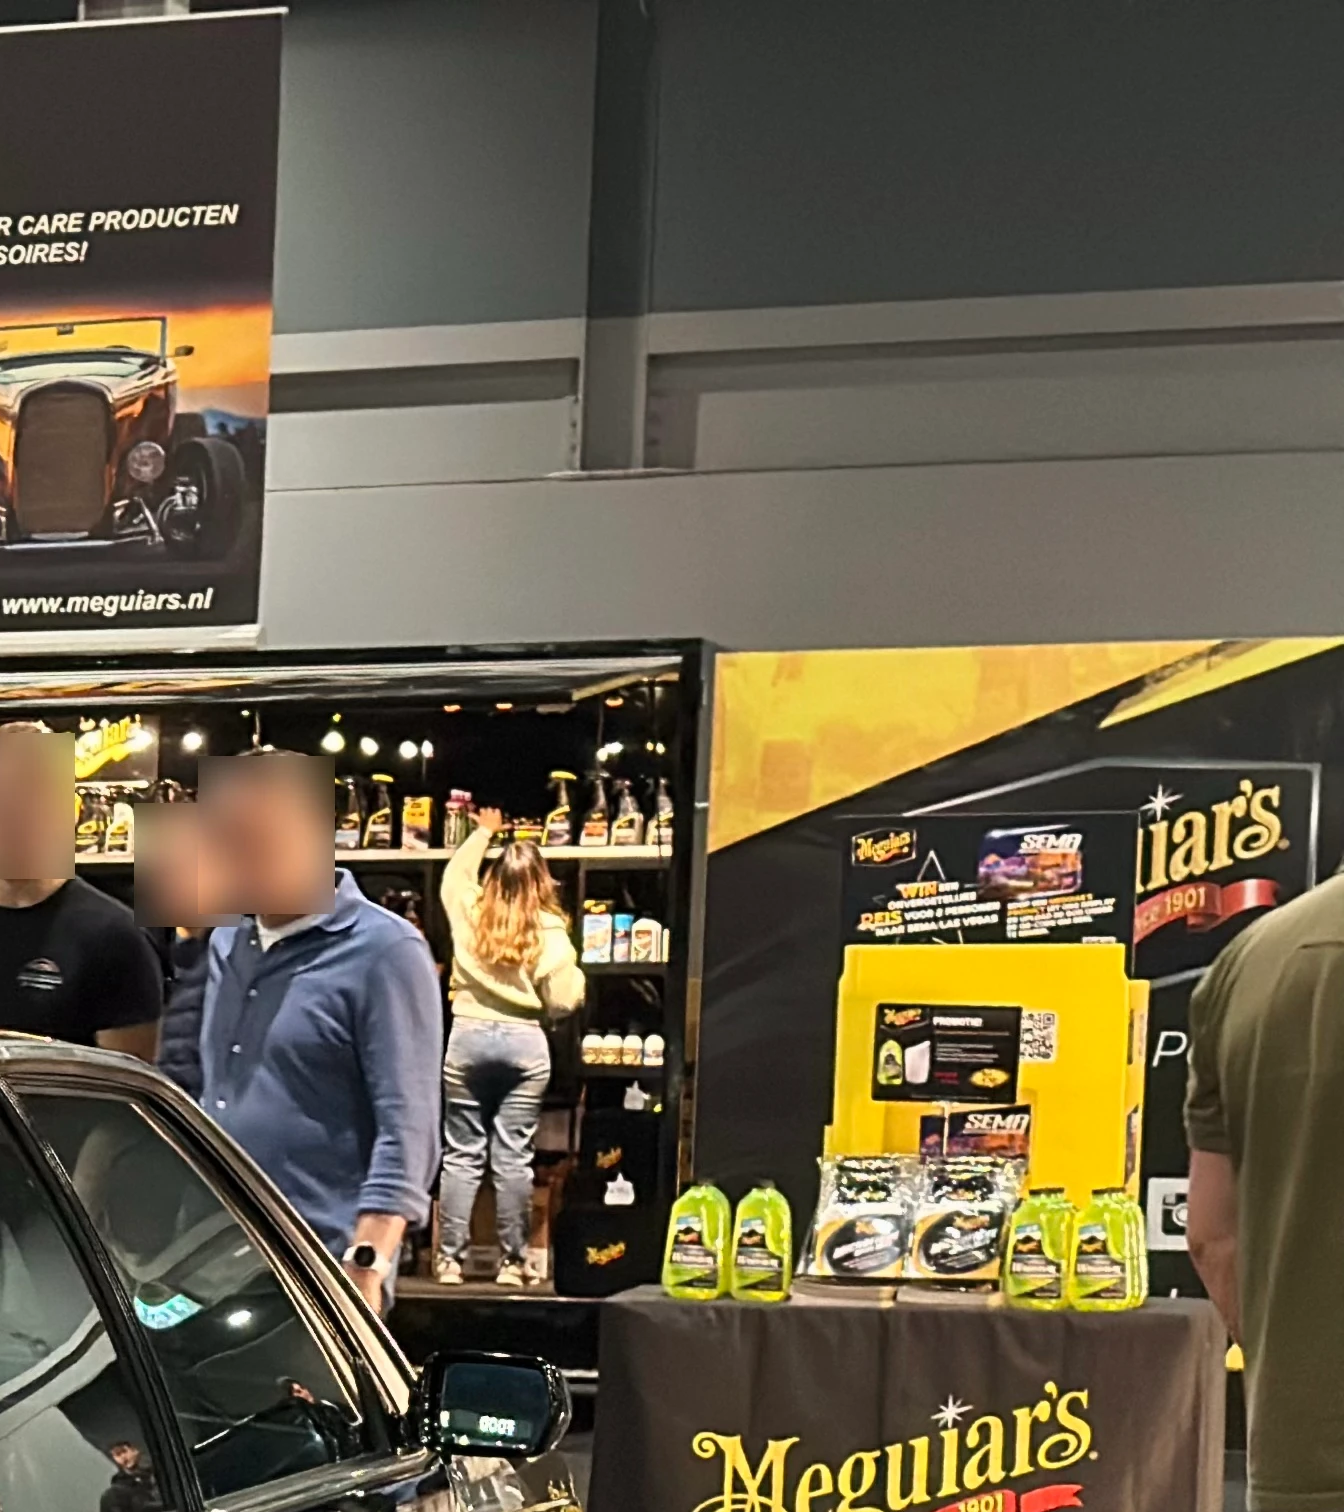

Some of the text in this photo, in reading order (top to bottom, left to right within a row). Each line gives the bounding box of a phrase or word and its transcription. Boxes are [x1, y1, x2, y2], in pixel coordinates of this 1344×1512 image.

[16, 212, 83, 236] CARE
[88, 203, 239, 232] PRODUCTEN
[1, 588, 213, 618] www.meguiars.nl
[1135, 778, 1282, 895] iar's
[1164, 885, 1207, 915] 1901
[1152, 1031, 1189, 1068] P
